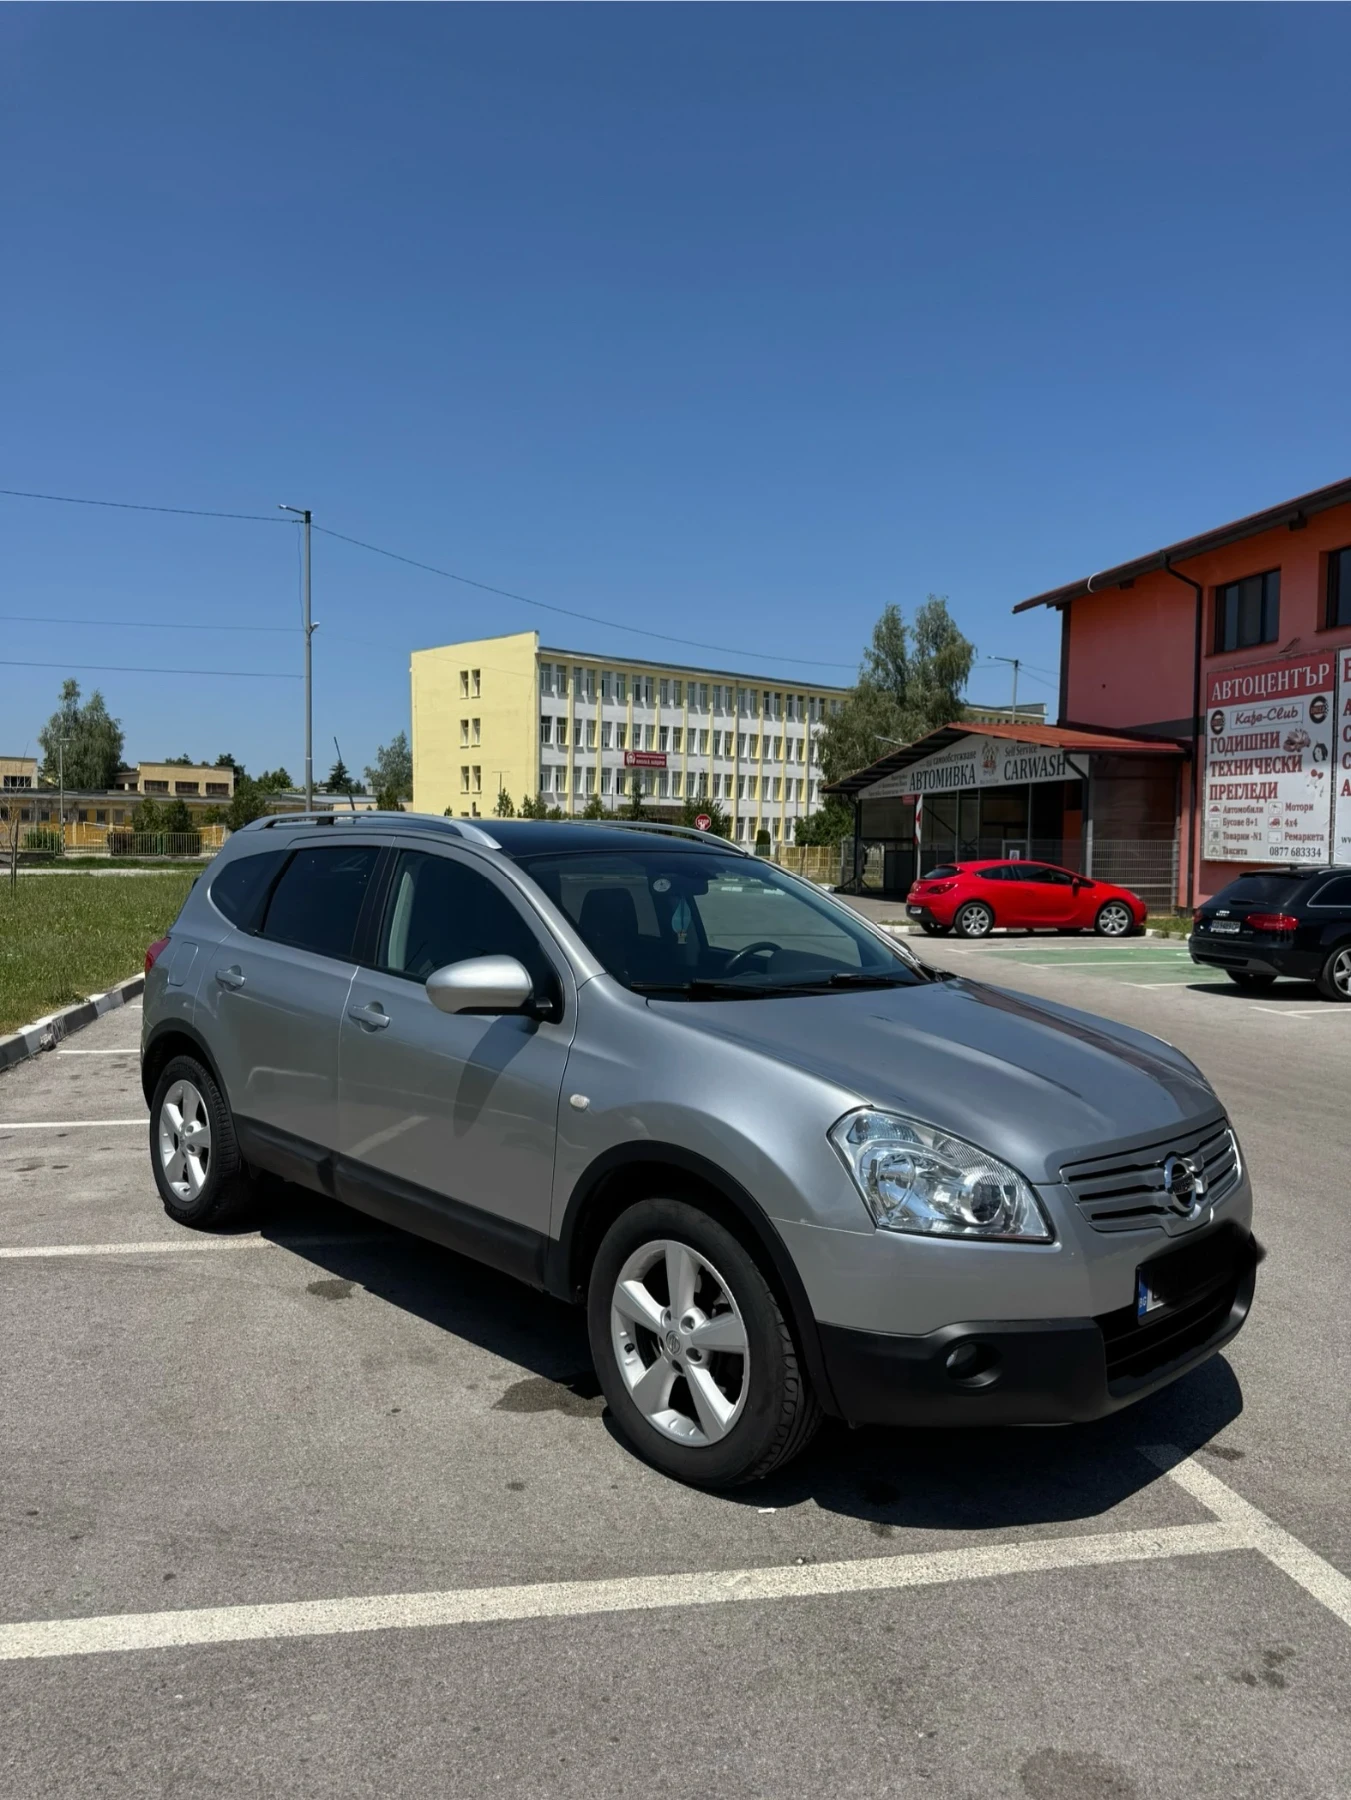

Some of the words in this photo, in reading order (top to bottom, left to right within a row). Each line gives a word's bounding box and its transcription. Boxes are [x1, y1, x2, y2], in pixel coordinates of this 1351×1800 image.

[1211, 663, 1330, 701] АВТОЦЕНТЪР
[1235, 706, 1299, 726] Kafe-Club
[1004, 744, 1016, 757] Self
[1016, 743, 1038, 756] Service
[1210, 731, 1280, 757] ГОДИШНИ
[1004, 754, 1066, 781] CARWASH
[1209, 754, 1303, 777] ТЕХНИЧЕСКИ
[909, 763, 976, 791] АВТОМИВКА
[1209, 781, 1279, 804] ПРЕГЛЕДИ
[1222, 805, 1264, 814] Автомобили
[1285, 802, 1314, 813] Мотори
[1222, 817, 1245, 828] Бусове
[1245, 817, 1258, 827] 8+1
[1284, 832, 1325, 843] Ремаркета
[1269, 846, 1289, 857] 0877
[1290, 847, 1322, 858] 683334
